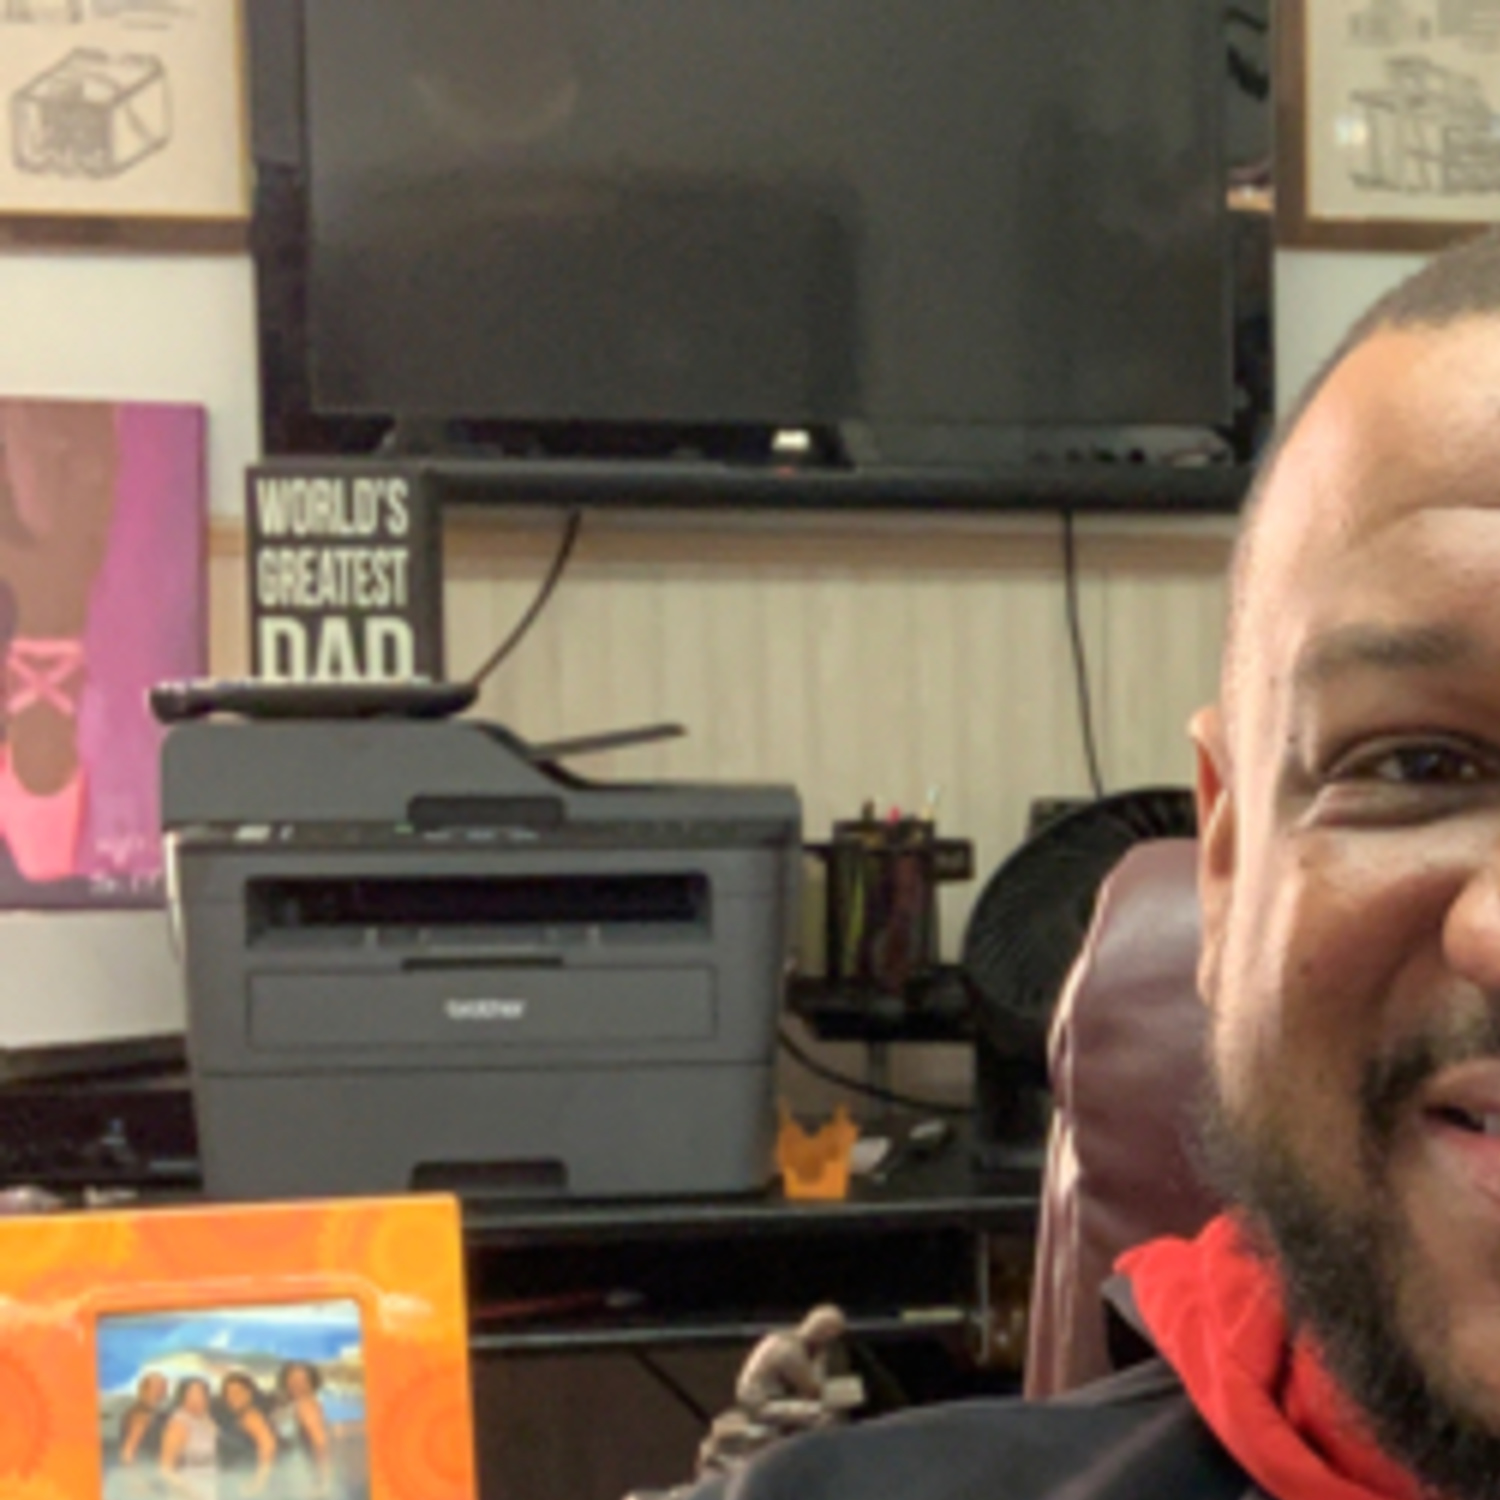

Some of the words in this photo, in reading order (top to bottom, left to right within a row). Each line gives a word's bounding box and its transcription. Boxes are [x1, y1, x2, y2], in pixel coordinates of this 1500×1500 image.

[256, 476, 409, 537] WORLD'S
[257, 547, 409, 608] GREATEST
[259, 615, 415, 683] DAD
